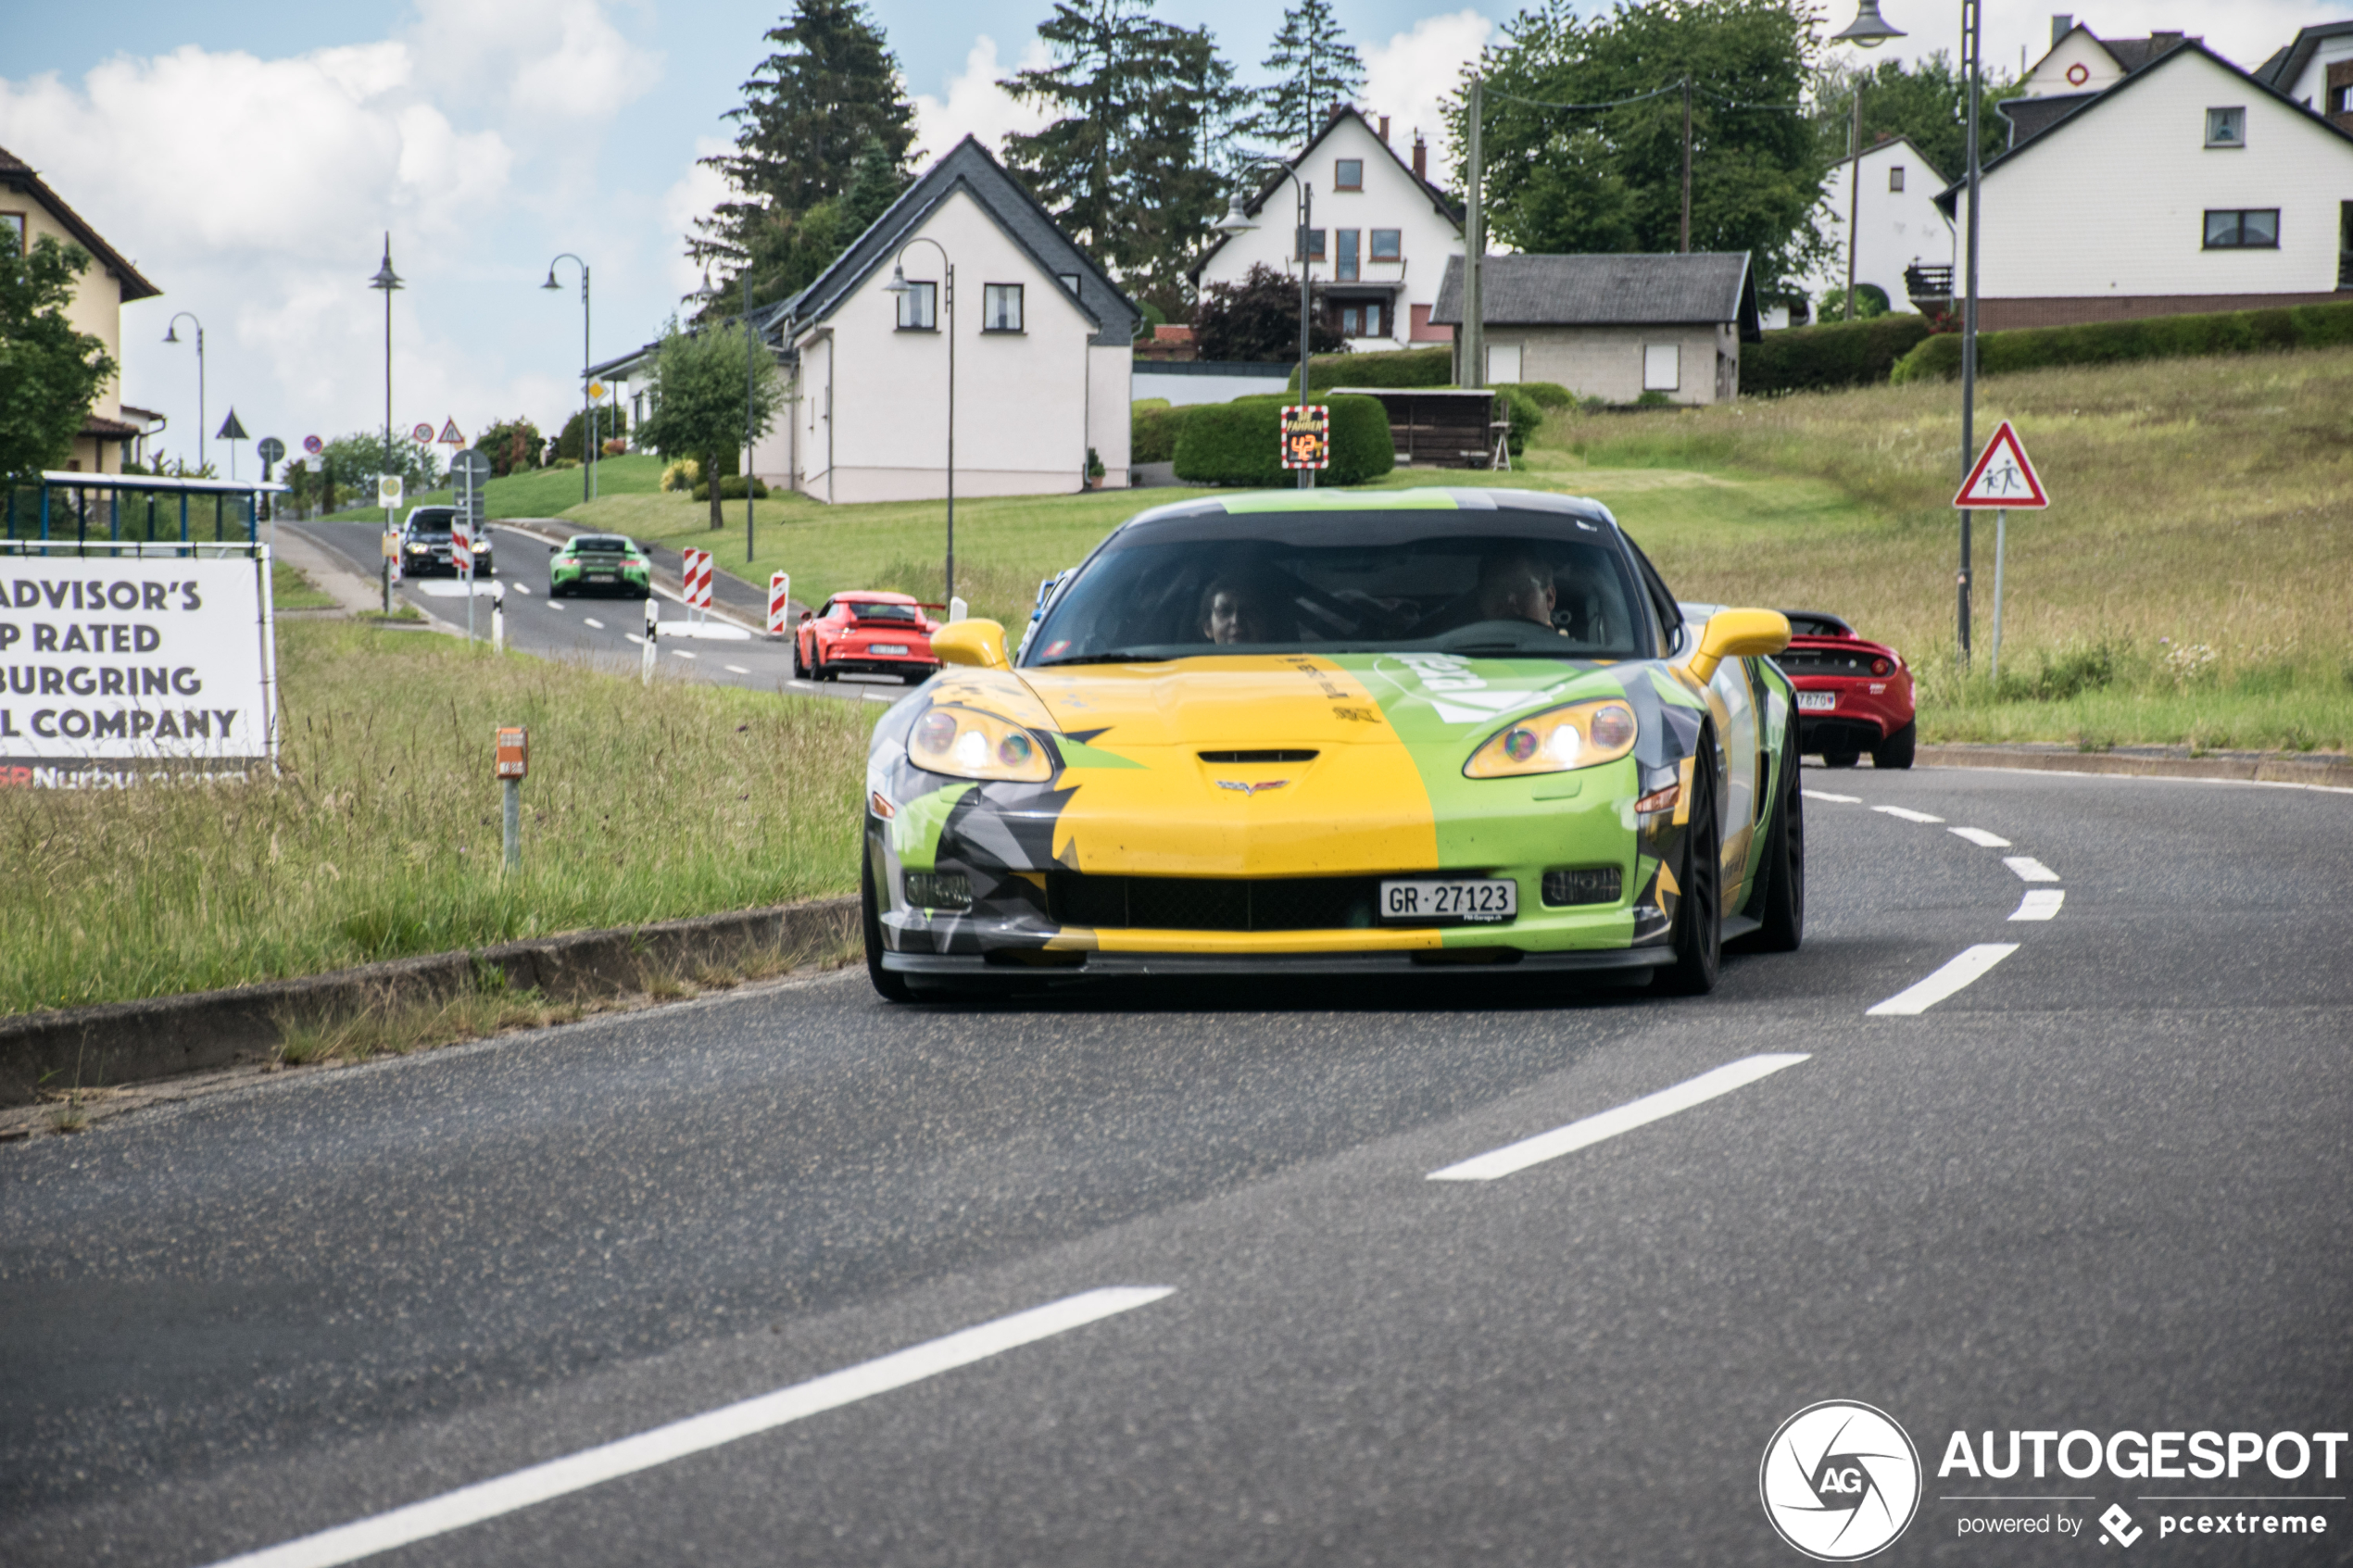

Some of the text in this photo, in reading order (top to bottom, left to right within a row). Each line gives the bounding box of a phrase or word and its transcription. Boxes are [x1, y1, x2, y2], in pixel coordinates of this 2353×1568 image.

[1287, 420, 1323, 432] FAHREN
[33, 623, 160, 652] RATED
[0, 667, 201, 696] URGRING
[1, 709, 238, 738] L COMPANY
[1435, 886, 1508, 912] 27123
